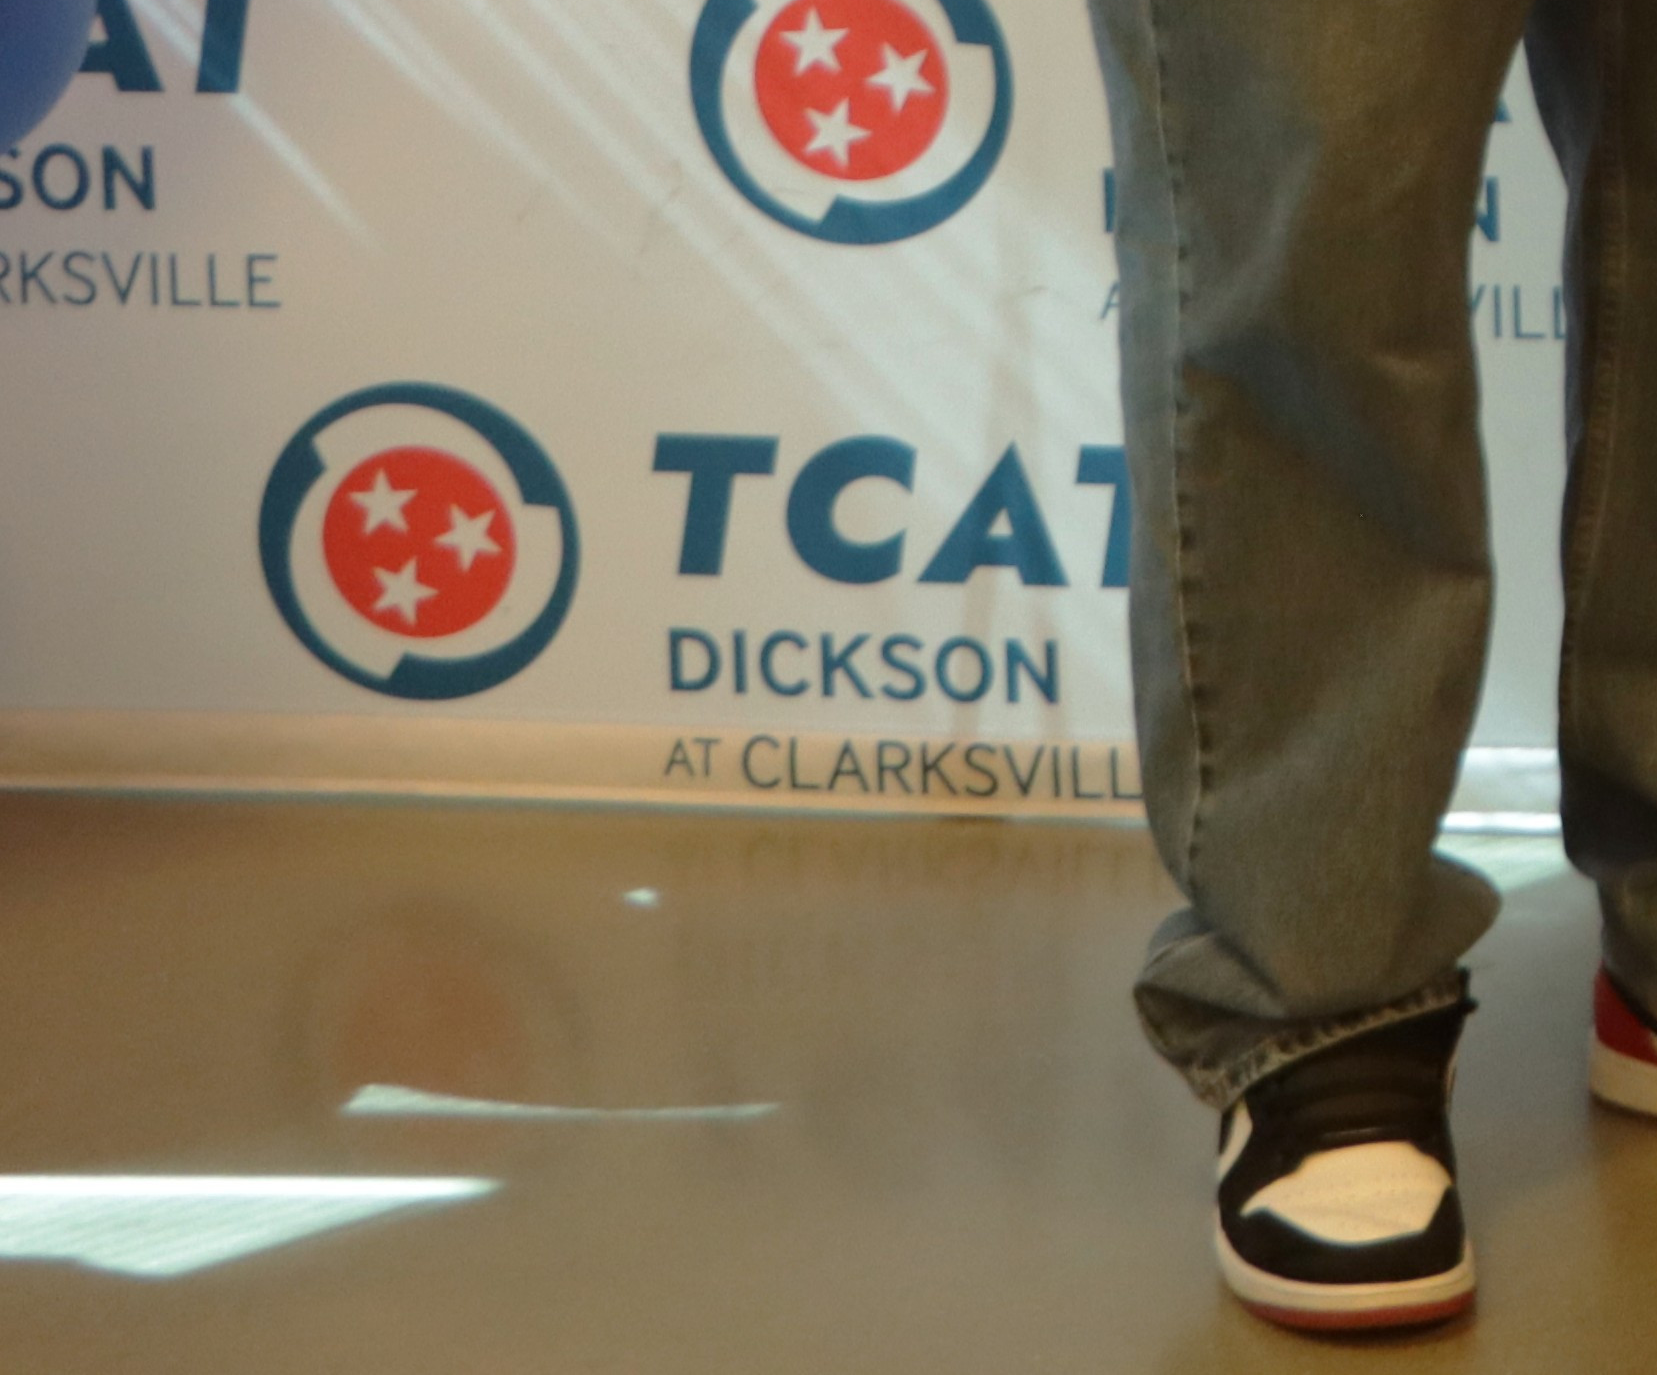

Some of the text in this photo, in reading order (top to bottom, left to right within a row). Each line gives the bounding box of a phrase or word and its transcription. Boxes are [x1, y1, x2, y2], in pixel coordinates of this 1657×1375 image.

[668, 626, 1059, 705] DICKSON
[664, 734, 1146, 800] AT CLARKSVILL
